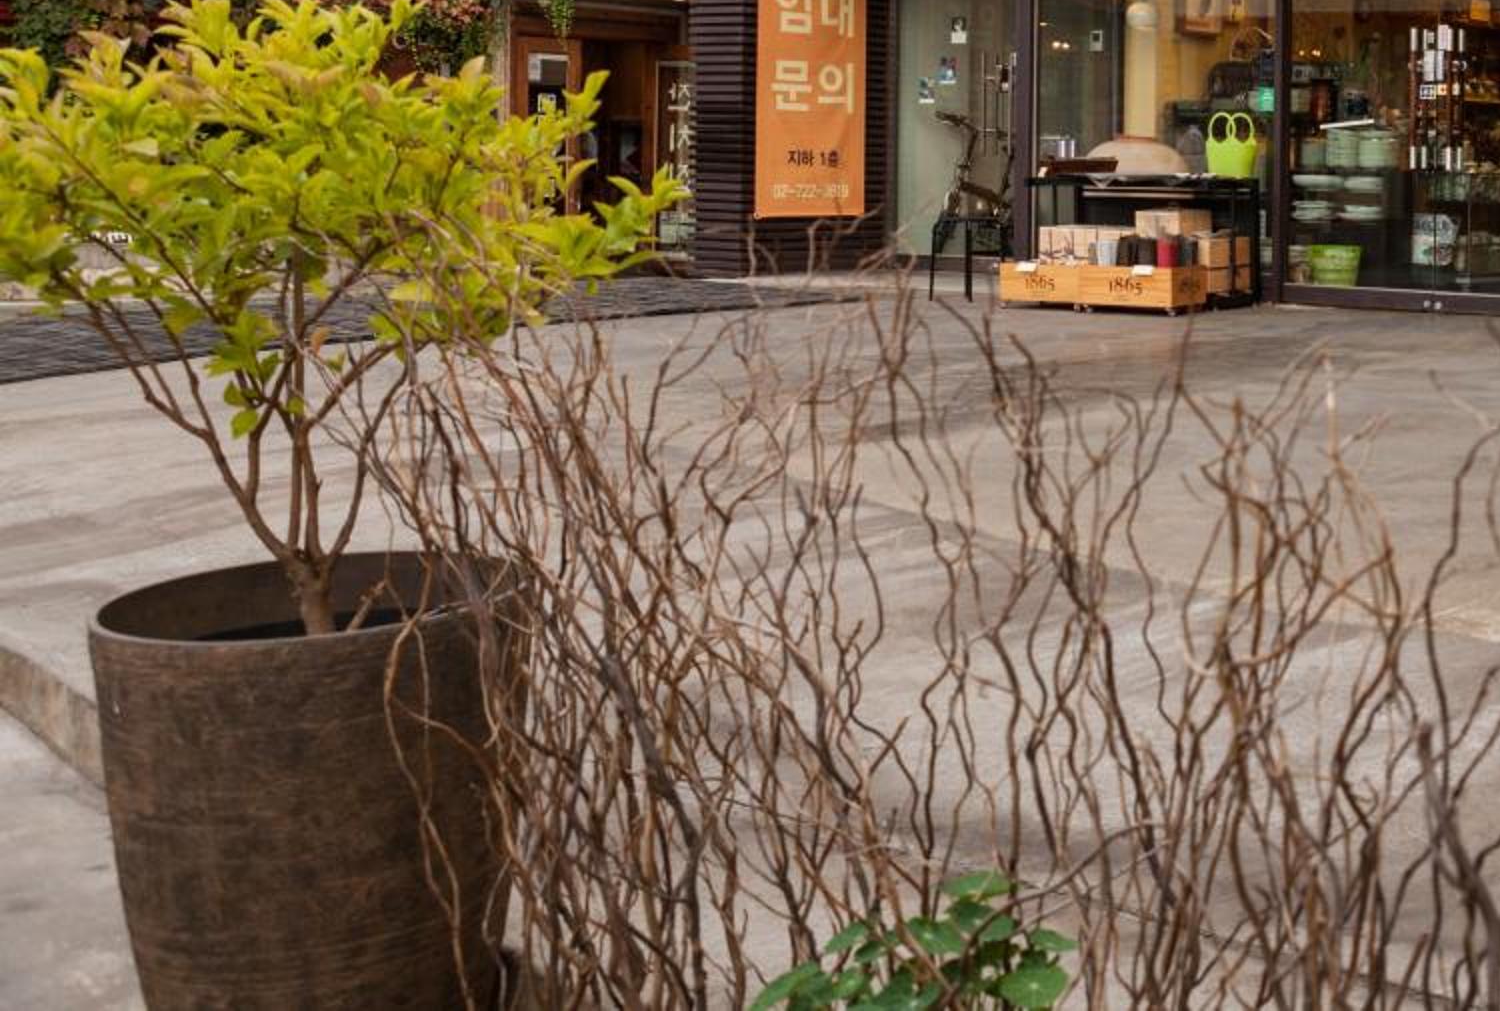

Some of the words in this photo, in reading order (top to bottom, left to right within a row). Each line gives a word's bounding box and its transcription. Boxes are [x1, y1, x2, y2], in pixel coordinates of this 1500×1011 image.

[770, 60, 855, 115] 문의
[787, 149, 815, 168] 지하
[1108, 276, 1144, 296] 1865
